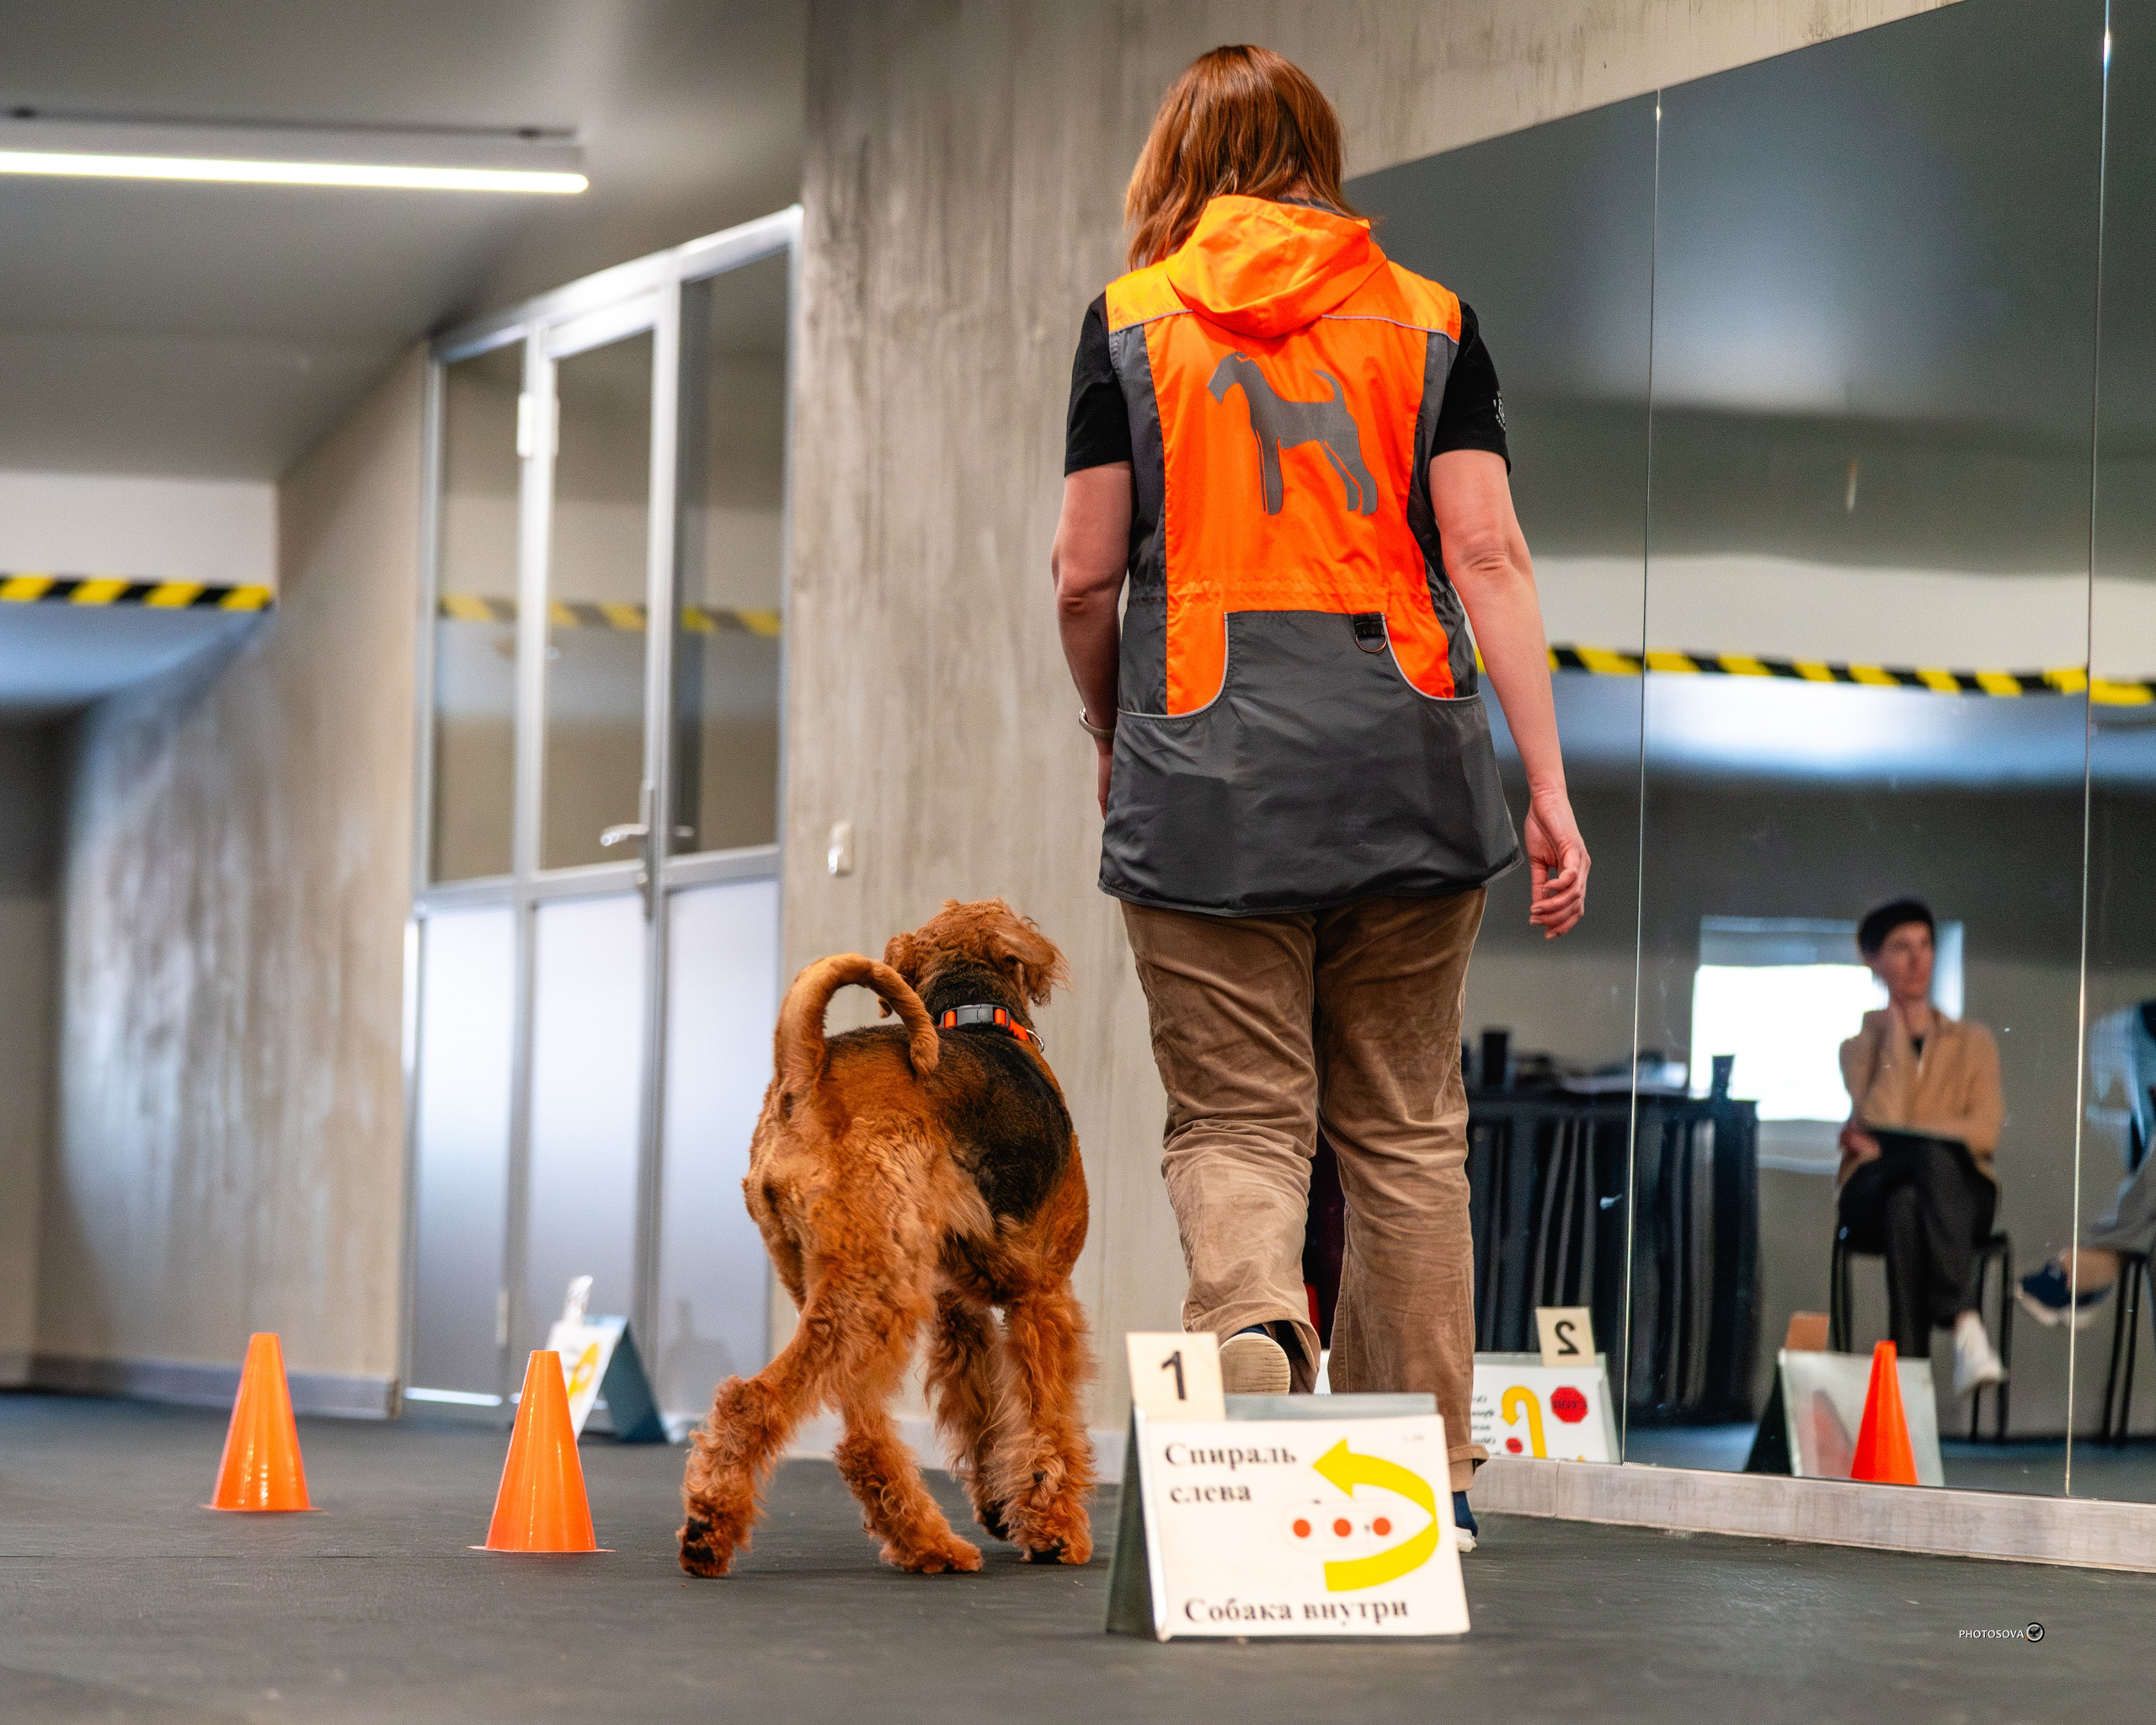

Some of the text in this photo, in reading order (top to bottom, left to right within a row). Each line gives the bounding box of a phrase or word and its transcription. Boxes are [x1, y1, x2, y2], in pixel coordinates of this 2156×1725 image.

[1161, 1350, 1186, 1401] 1
[1164, 1442, 1297, 1471] Спираль
[1170, 1485, 1251, 1503] слева
[1183, 1597, 1409, 1626] Собака внутри
